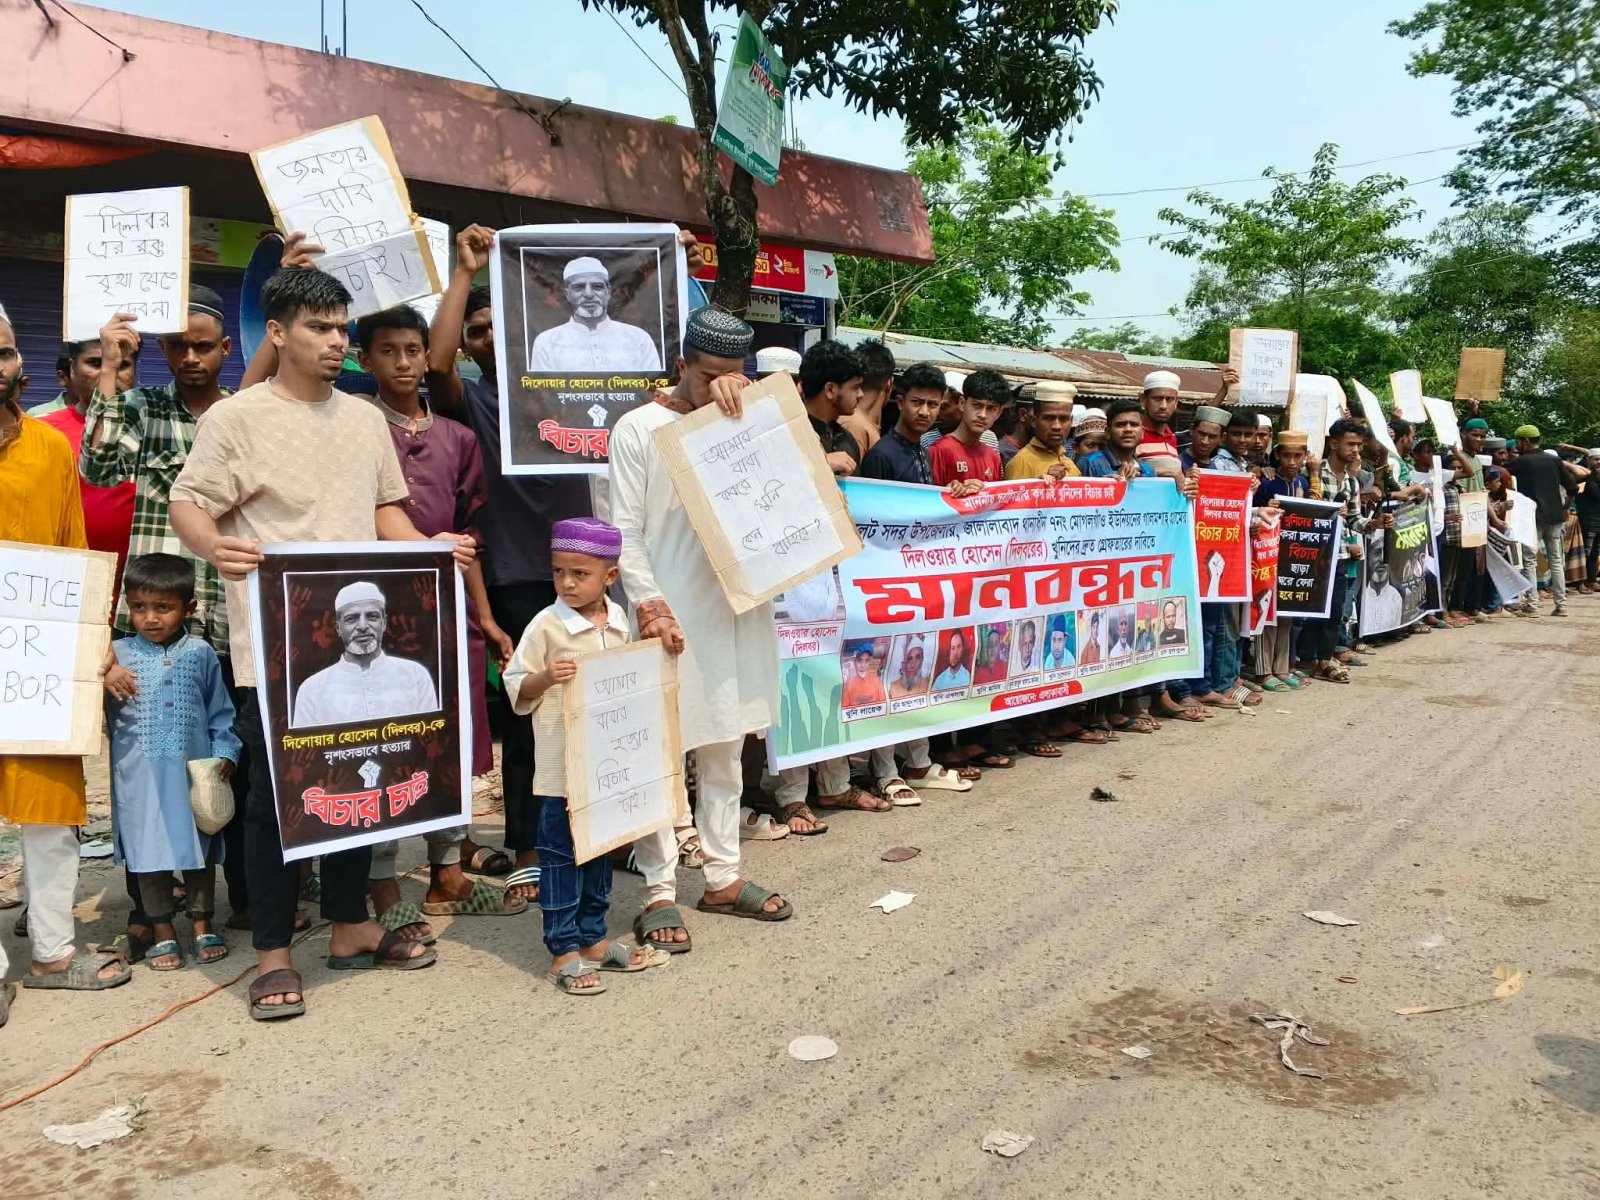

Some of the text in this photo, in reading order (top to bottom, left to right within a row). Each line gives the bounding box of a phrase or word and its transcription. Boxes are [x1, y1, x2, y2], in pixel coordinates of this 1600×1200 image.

[277, 145, 367, 184] জনতার
[302, 172, 374, 213] দাবি
[84, 205, 169, 238] দিলবর
[308, 215, 389, 249] বিচার
[87, 239, 164, 258] এর রক্ত
[85, 272, 178, 297] বৃথা যেতে
[521, 376, 566, 389] দিলোয়ার
[569, 377, 604, 389] হোসেন
[557, 392, 636, 405] নৃশংসভাবে হত্যার
[538, 419, 610, 459] বিচার
[730, 449, 762, 474] বাবা
[1085, 483, 1102, 500] বিচার
[1104, 484, 1115, 500] চাই
[881, 523, 906, 541] সদর
[962, 517, 1020, 538] জালালাবাদ
[1050, 515, 1067, 531] ৭নং
[1108, 507, 1141, 529] ইউনিয়নের
[1195, 521, 1222, 542] বিচার
[1225, 524, 1240, 543] চাই
[1314, 518, 1333, 530] রক্ষা
[900, 543, 957, 569] দিলওয়ার
[962, 544, 1002, 566] হোসেন
[1051, 536, 1081, 560] খুনিদের
[1134, 531, 1156, 550] দাবিতে
[1289, 543, 1319, 560] বিচার
[1290, 563, 1310, 577] ছাড়া
[811, 625, 837, 639] হোসেন
[3, 670, 63, 707] BOR
[846, 708, 858, 719] খুনি
[282, 733, 334, 751] দিলোয়ার
[338, 728, 377, 744] হোসেন
[323, 739, 412, 766] নৃশংসভাবে হত্যার
[301, 770, 429, 828] বিচার চাই
